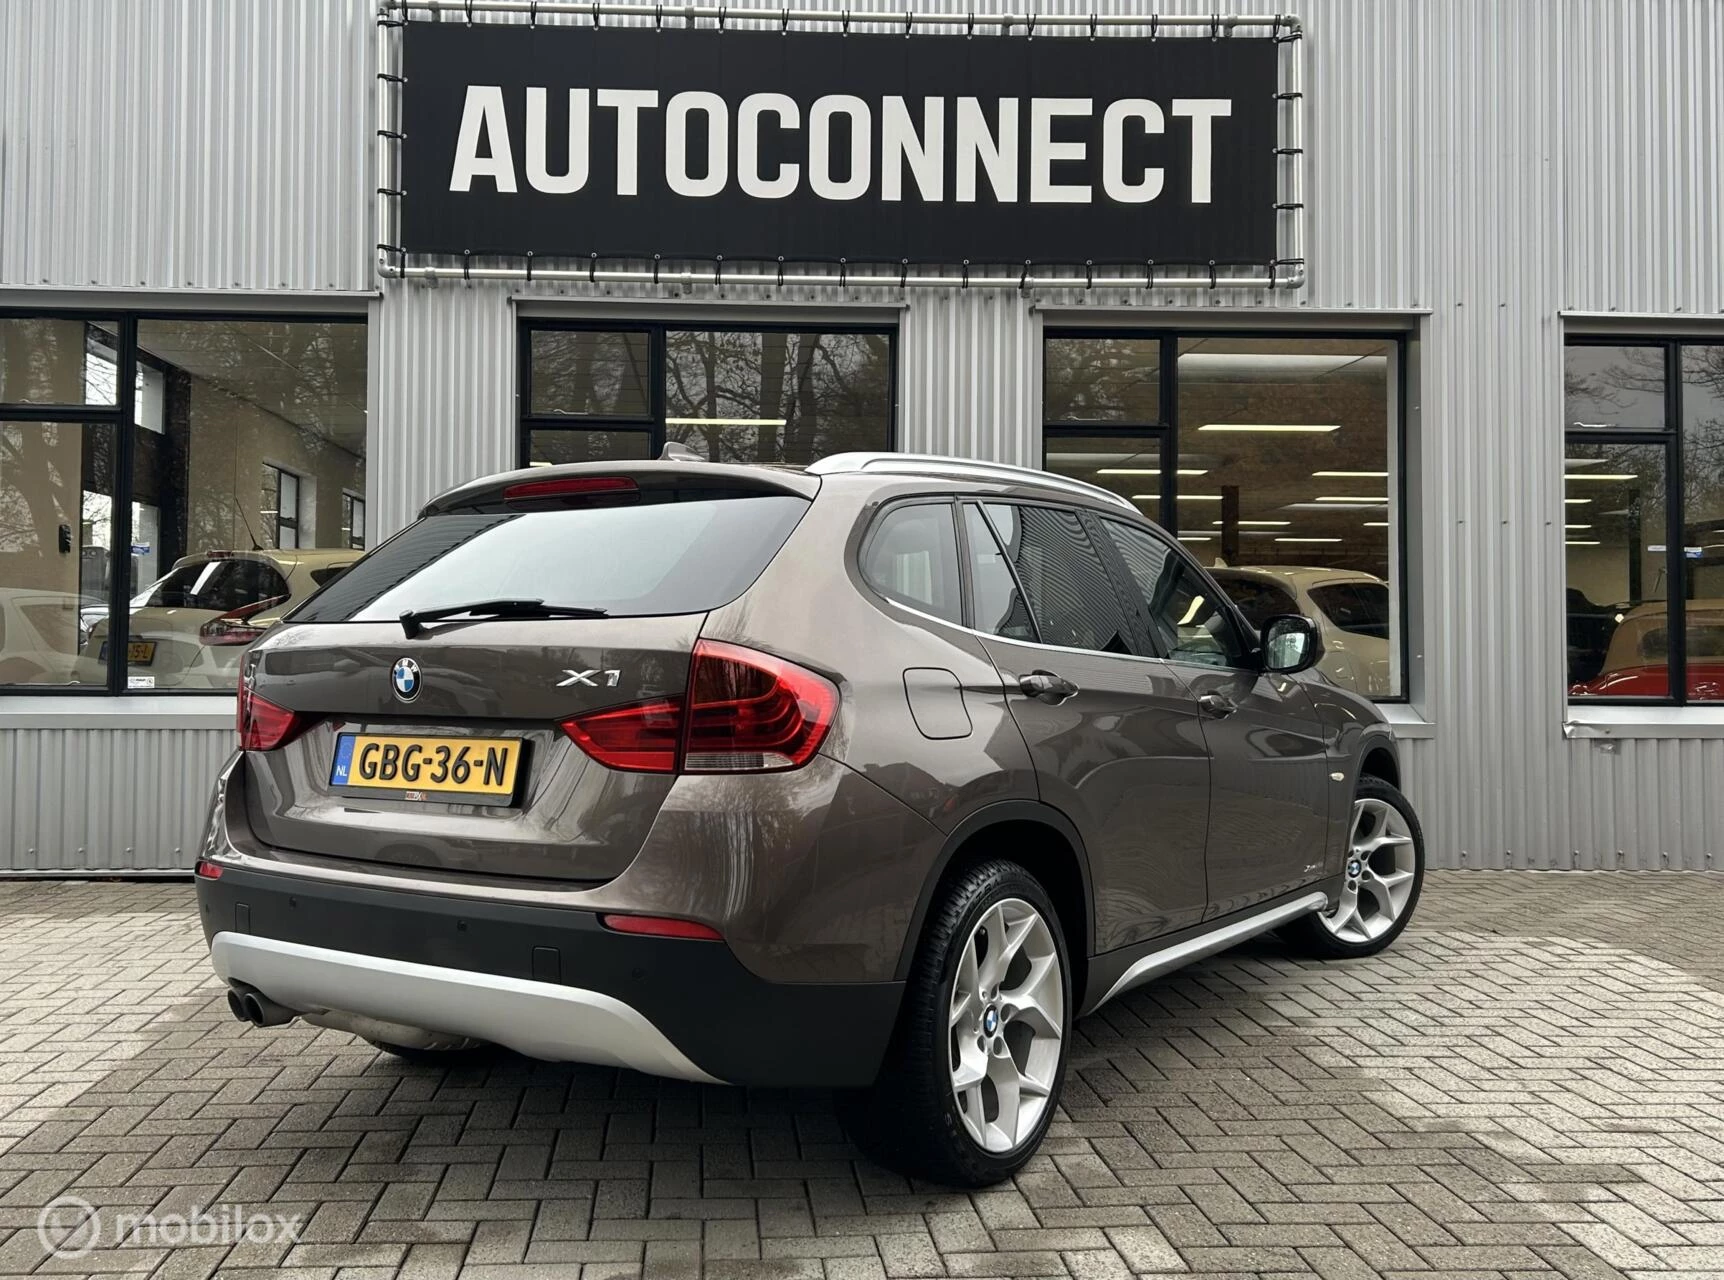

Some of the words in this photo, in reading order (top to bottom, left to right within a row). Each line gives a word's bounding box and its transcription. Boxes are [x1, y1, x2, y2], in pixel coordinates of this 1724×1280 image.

[449, 84, 1232, 205] AUTOCONNECT
[128, 643, 150, 659] -15-L
[556, 669, 621, 687] X1
[335, 765, 348, 777] NL
[359, 743, 508, 786] GBG-36-N
